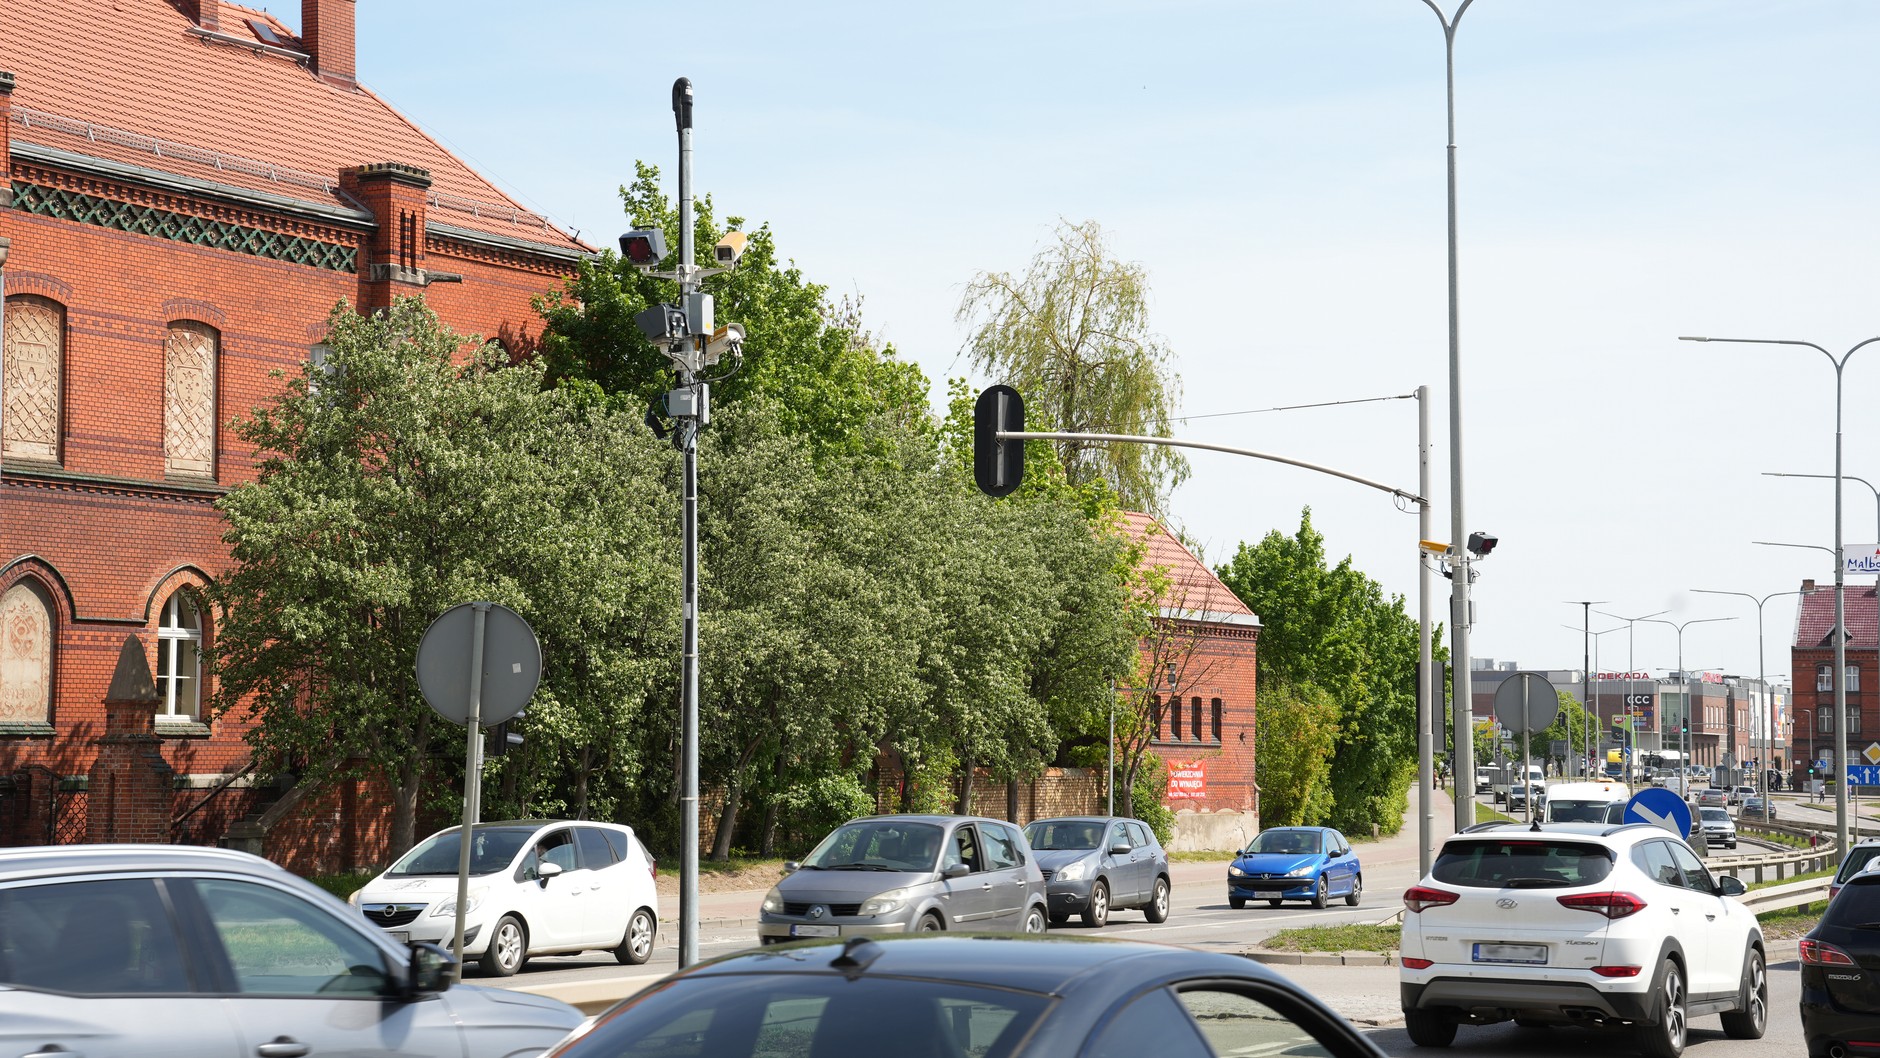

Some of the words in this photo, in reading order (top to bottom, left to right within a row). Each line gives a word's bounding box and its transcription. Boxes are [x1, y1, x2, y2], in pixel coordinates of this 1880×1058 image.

[1598, 672, 1650, 680] DEKADA
[1627, 695, 1650, 704] CCC
[1170, 780, 1178, 788] DO
